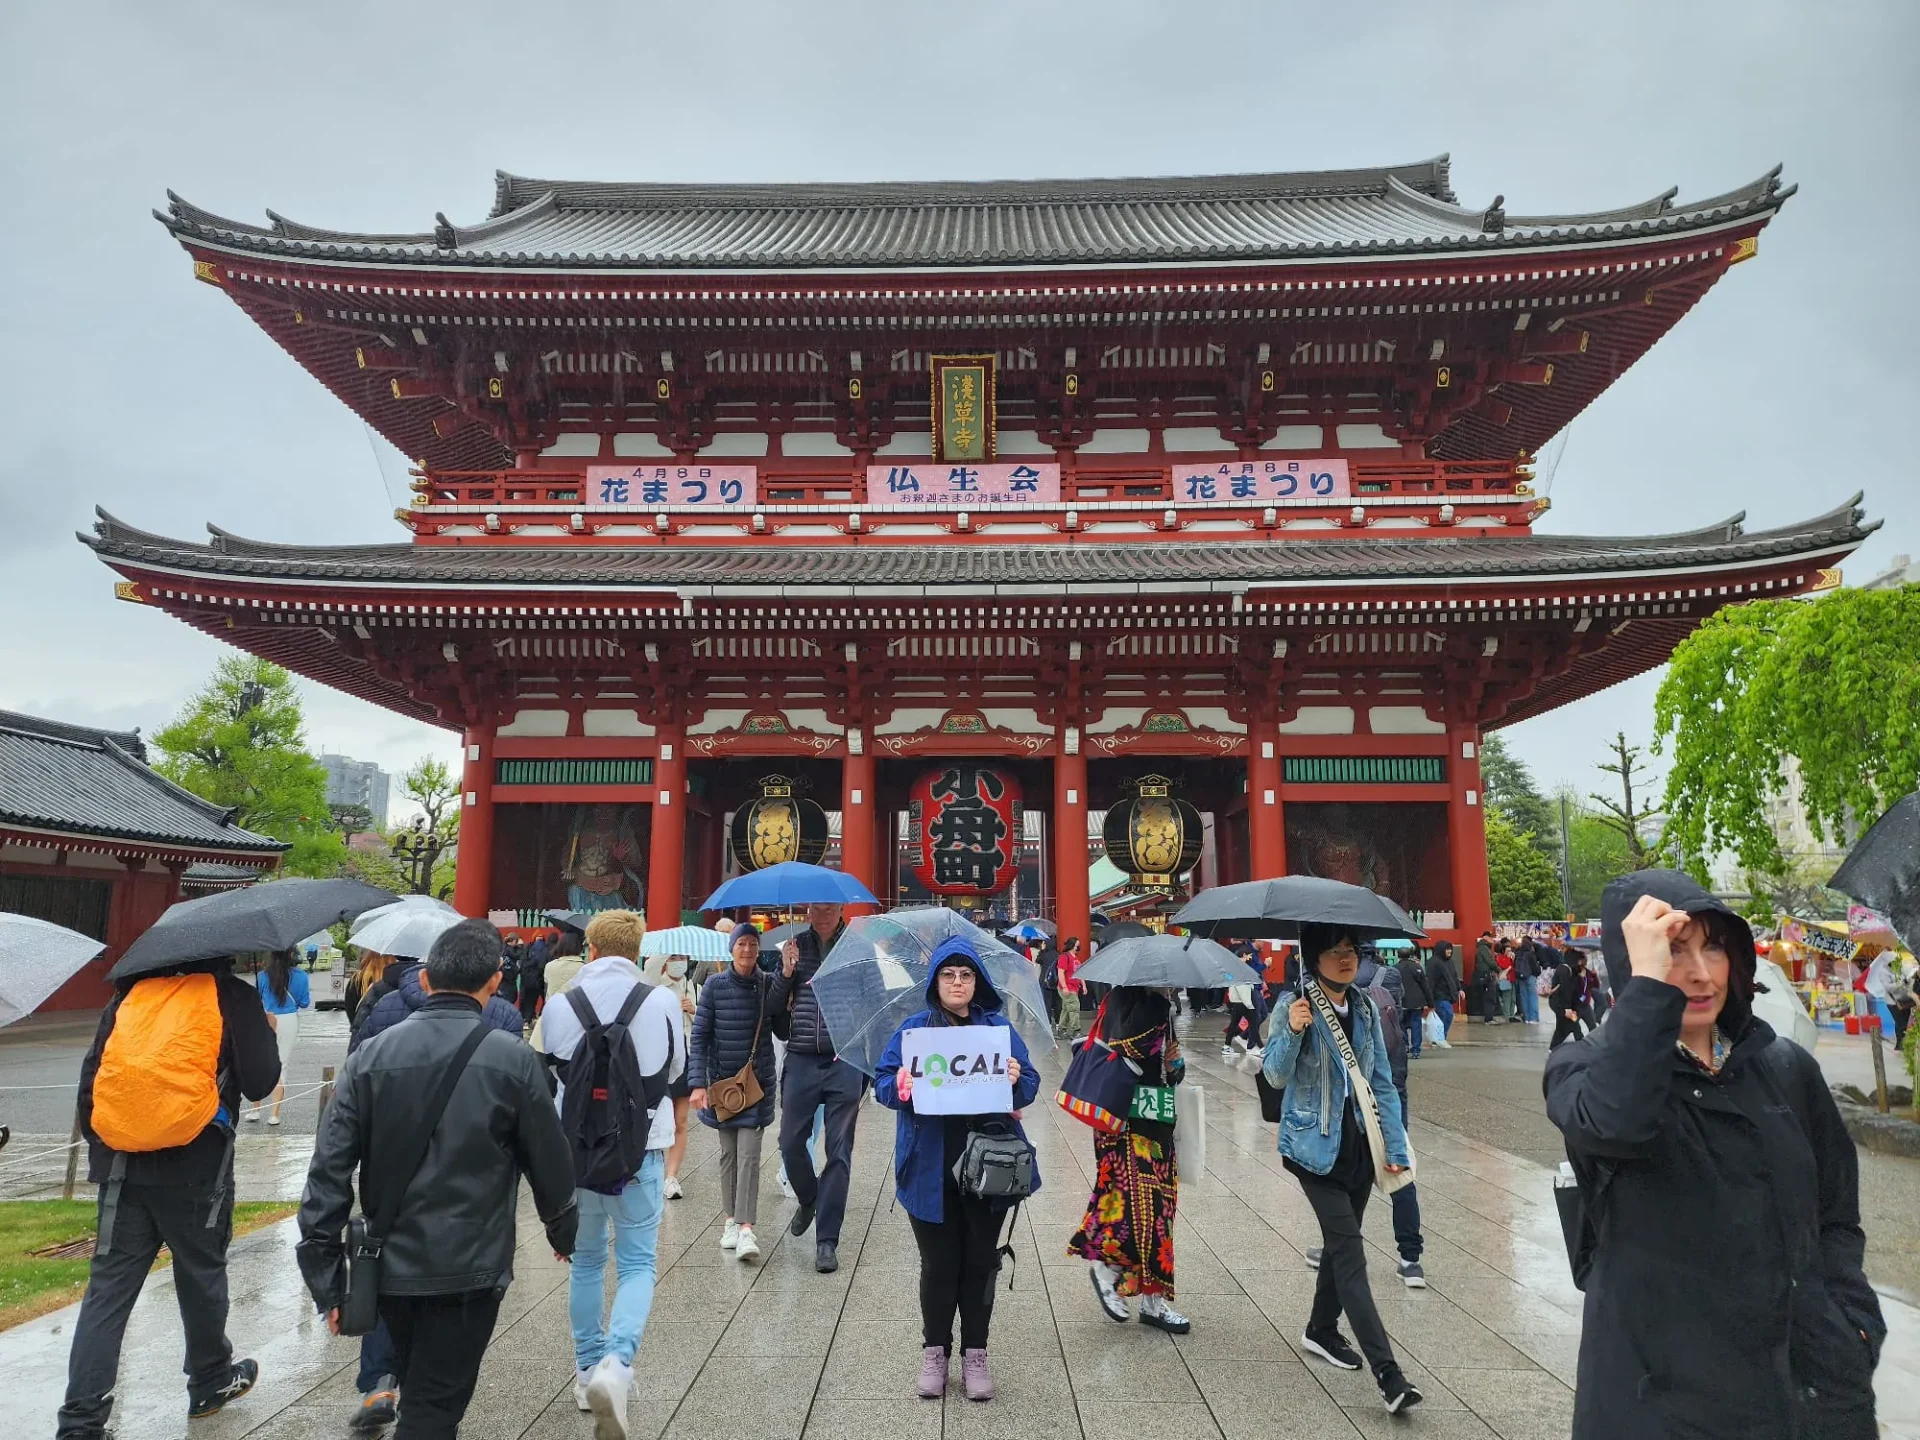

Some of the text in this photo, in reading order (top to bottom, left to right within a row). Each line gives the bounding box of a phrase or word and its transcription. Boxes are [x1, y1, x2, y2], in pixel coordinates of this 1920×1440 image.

[632, 467, 711, 479] 4月8日
[886, 465, 1040, 493] 仏生会
[1218, 462, 1300, 476] 4月8日
[600, 478, 743, 503] 花まつり
[900, 492, 1027, 503] お釈迦さまのお誕生日
[1186, 472, 1334, 500] 花まつり
[1325, 1015, 1340, 1033] DU
[911, 1053, 1004, 1079] LOCAL
[1163, 1092, 1174, 1118] EXIT
